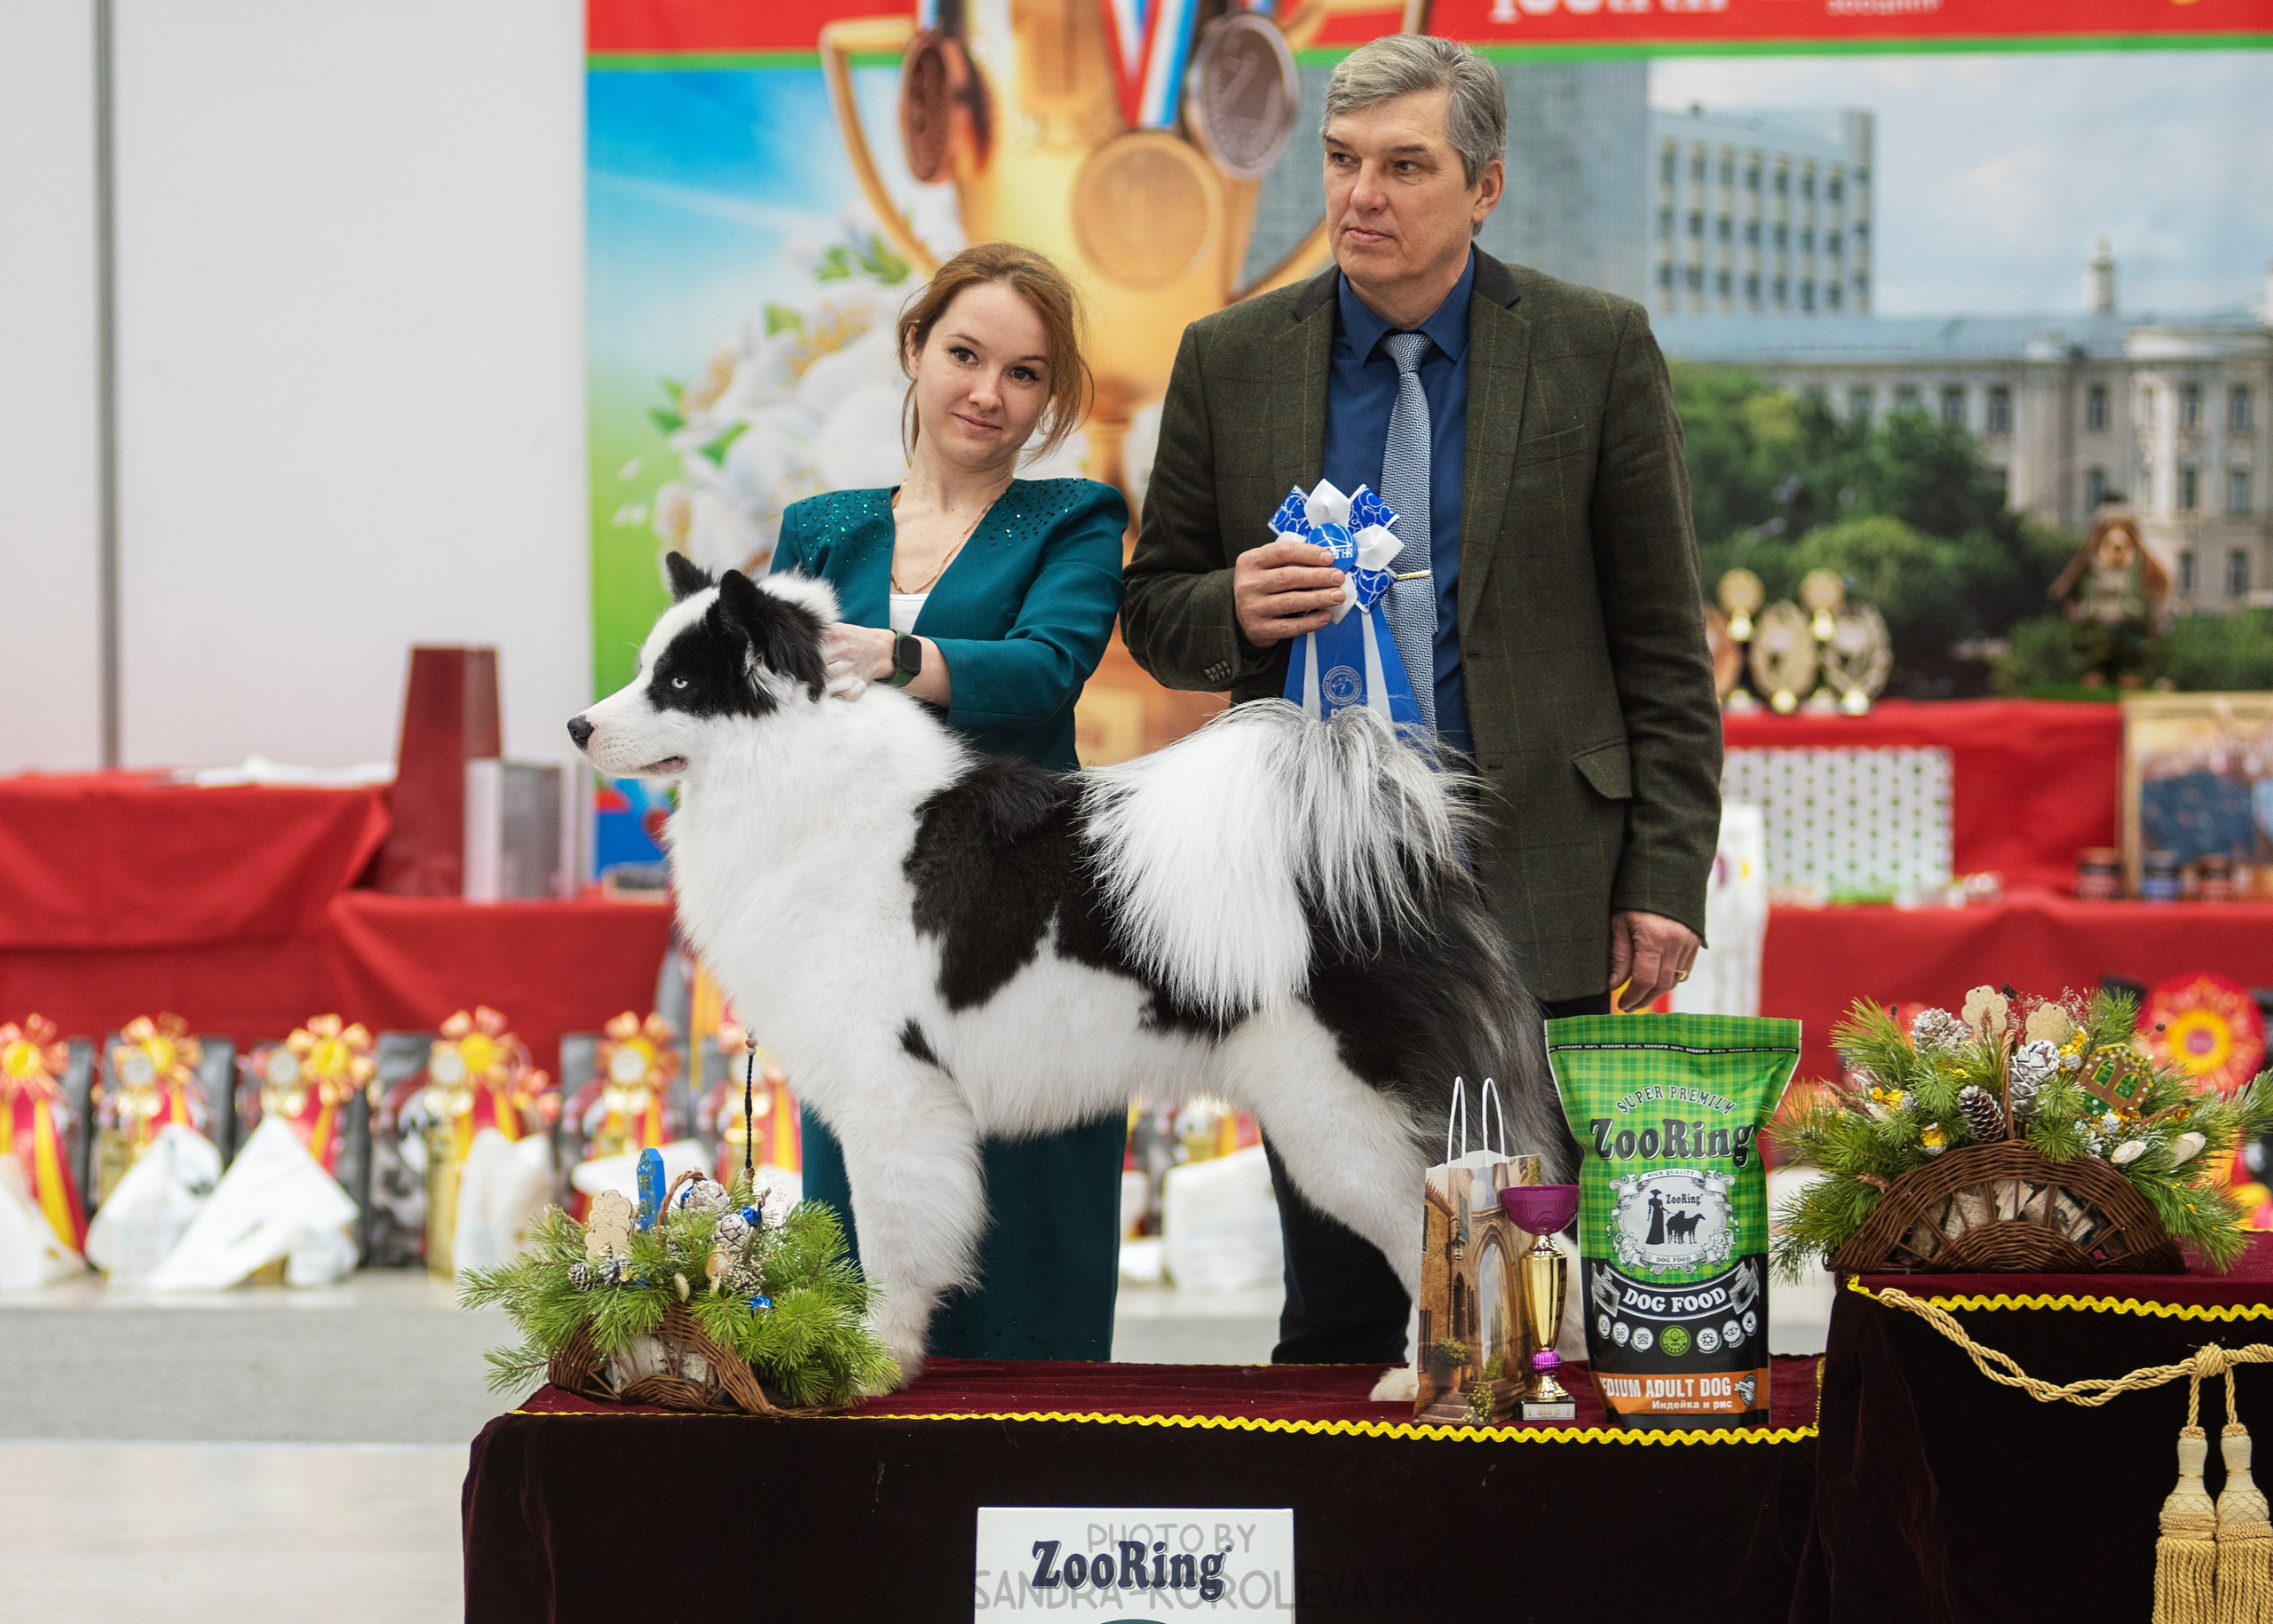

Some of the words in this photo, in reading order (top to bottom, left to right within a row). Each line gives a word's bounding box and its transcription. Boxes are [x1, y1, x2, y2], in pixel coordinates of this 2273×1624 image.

[1616, 1085, 1665, 1114] SUPER
[1669, 1085, 1737, 1114] PREMIUM
[1589, 1118, 1754, 1168] ZooRing
[1666, 1193, 1701, 1207] ZooRing
[1622, 1287, 1666, 1312] DOG
[1671, 1287, 1727, 1312] FOOD
[1644, 1378, 1695, 1398] ADULT
[1699, 1377, 1732, 1397] DOG
[1651, 1400, 1699, 1411] Индейка
[1713, 1400, 1733, 1411] рис
